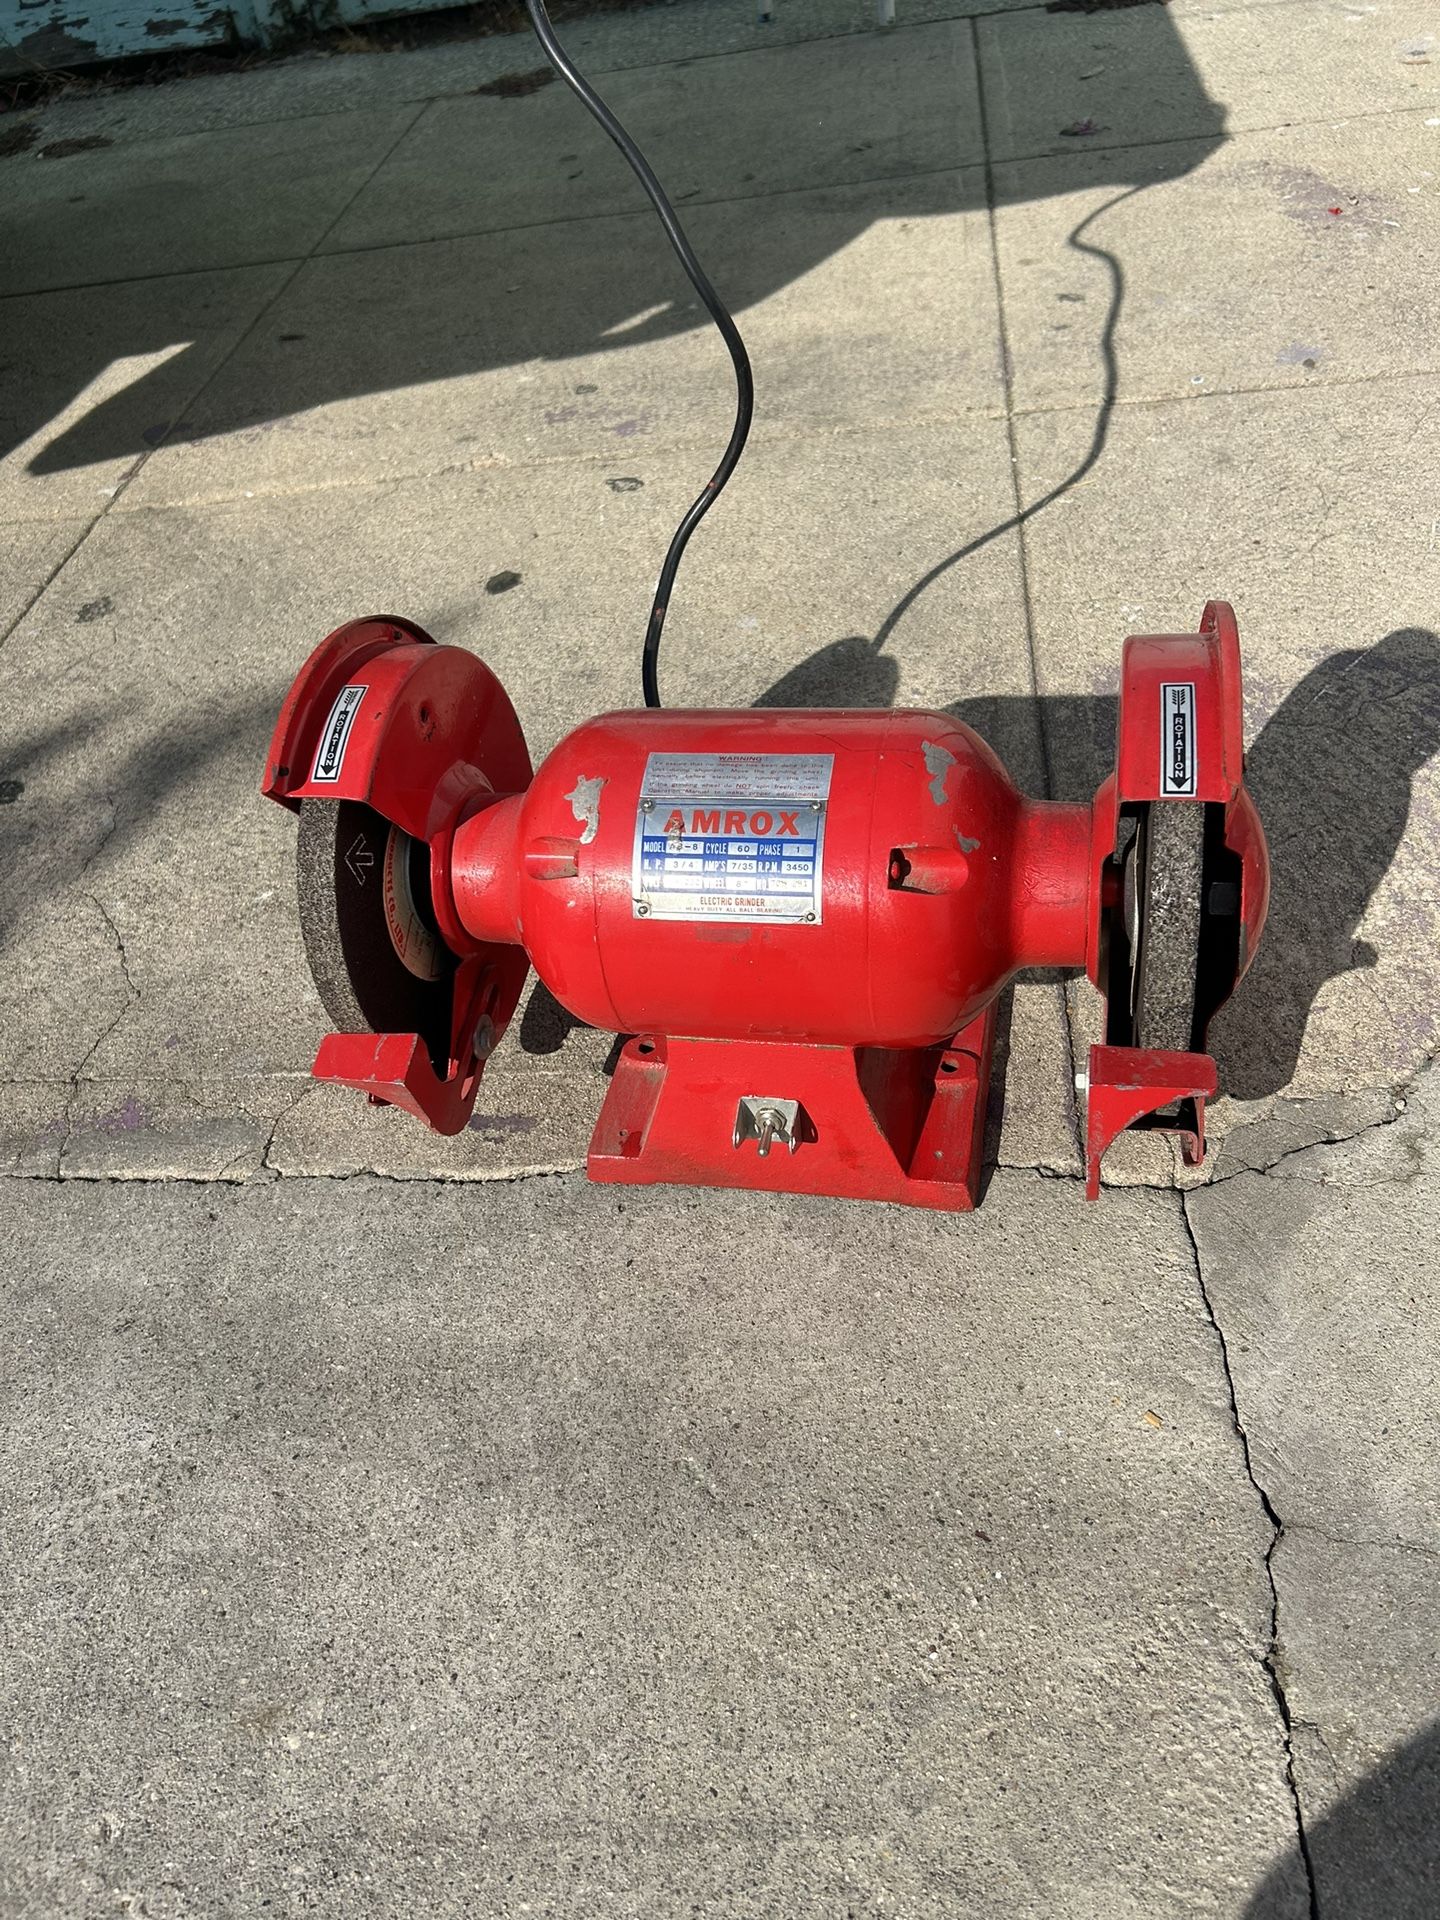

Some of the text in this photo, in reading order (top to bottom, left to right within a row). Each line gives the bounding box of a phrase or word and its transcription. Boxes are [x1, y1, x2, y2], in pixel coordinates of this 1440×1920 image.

[325, 713, 346, 766] ROTATION
[1174, 717, 1184, 778] ROTATION
[663, 809, 801, 836] AMROX
[643, 841, 665, 853] MODEL
[705, 842, 727, 854] CYCLE
[737, 845, 750, 853] 60
[759, 844, 781, 855] PHASE
[796, 845, 800, 853] 1
[704, 860, 726, 872] AMP'S
[732, 862, 754, 870] 7/35
[786, 863, 809, 871] 3450
[700, 896, 766, 907] ELECTRIC GRINDER
